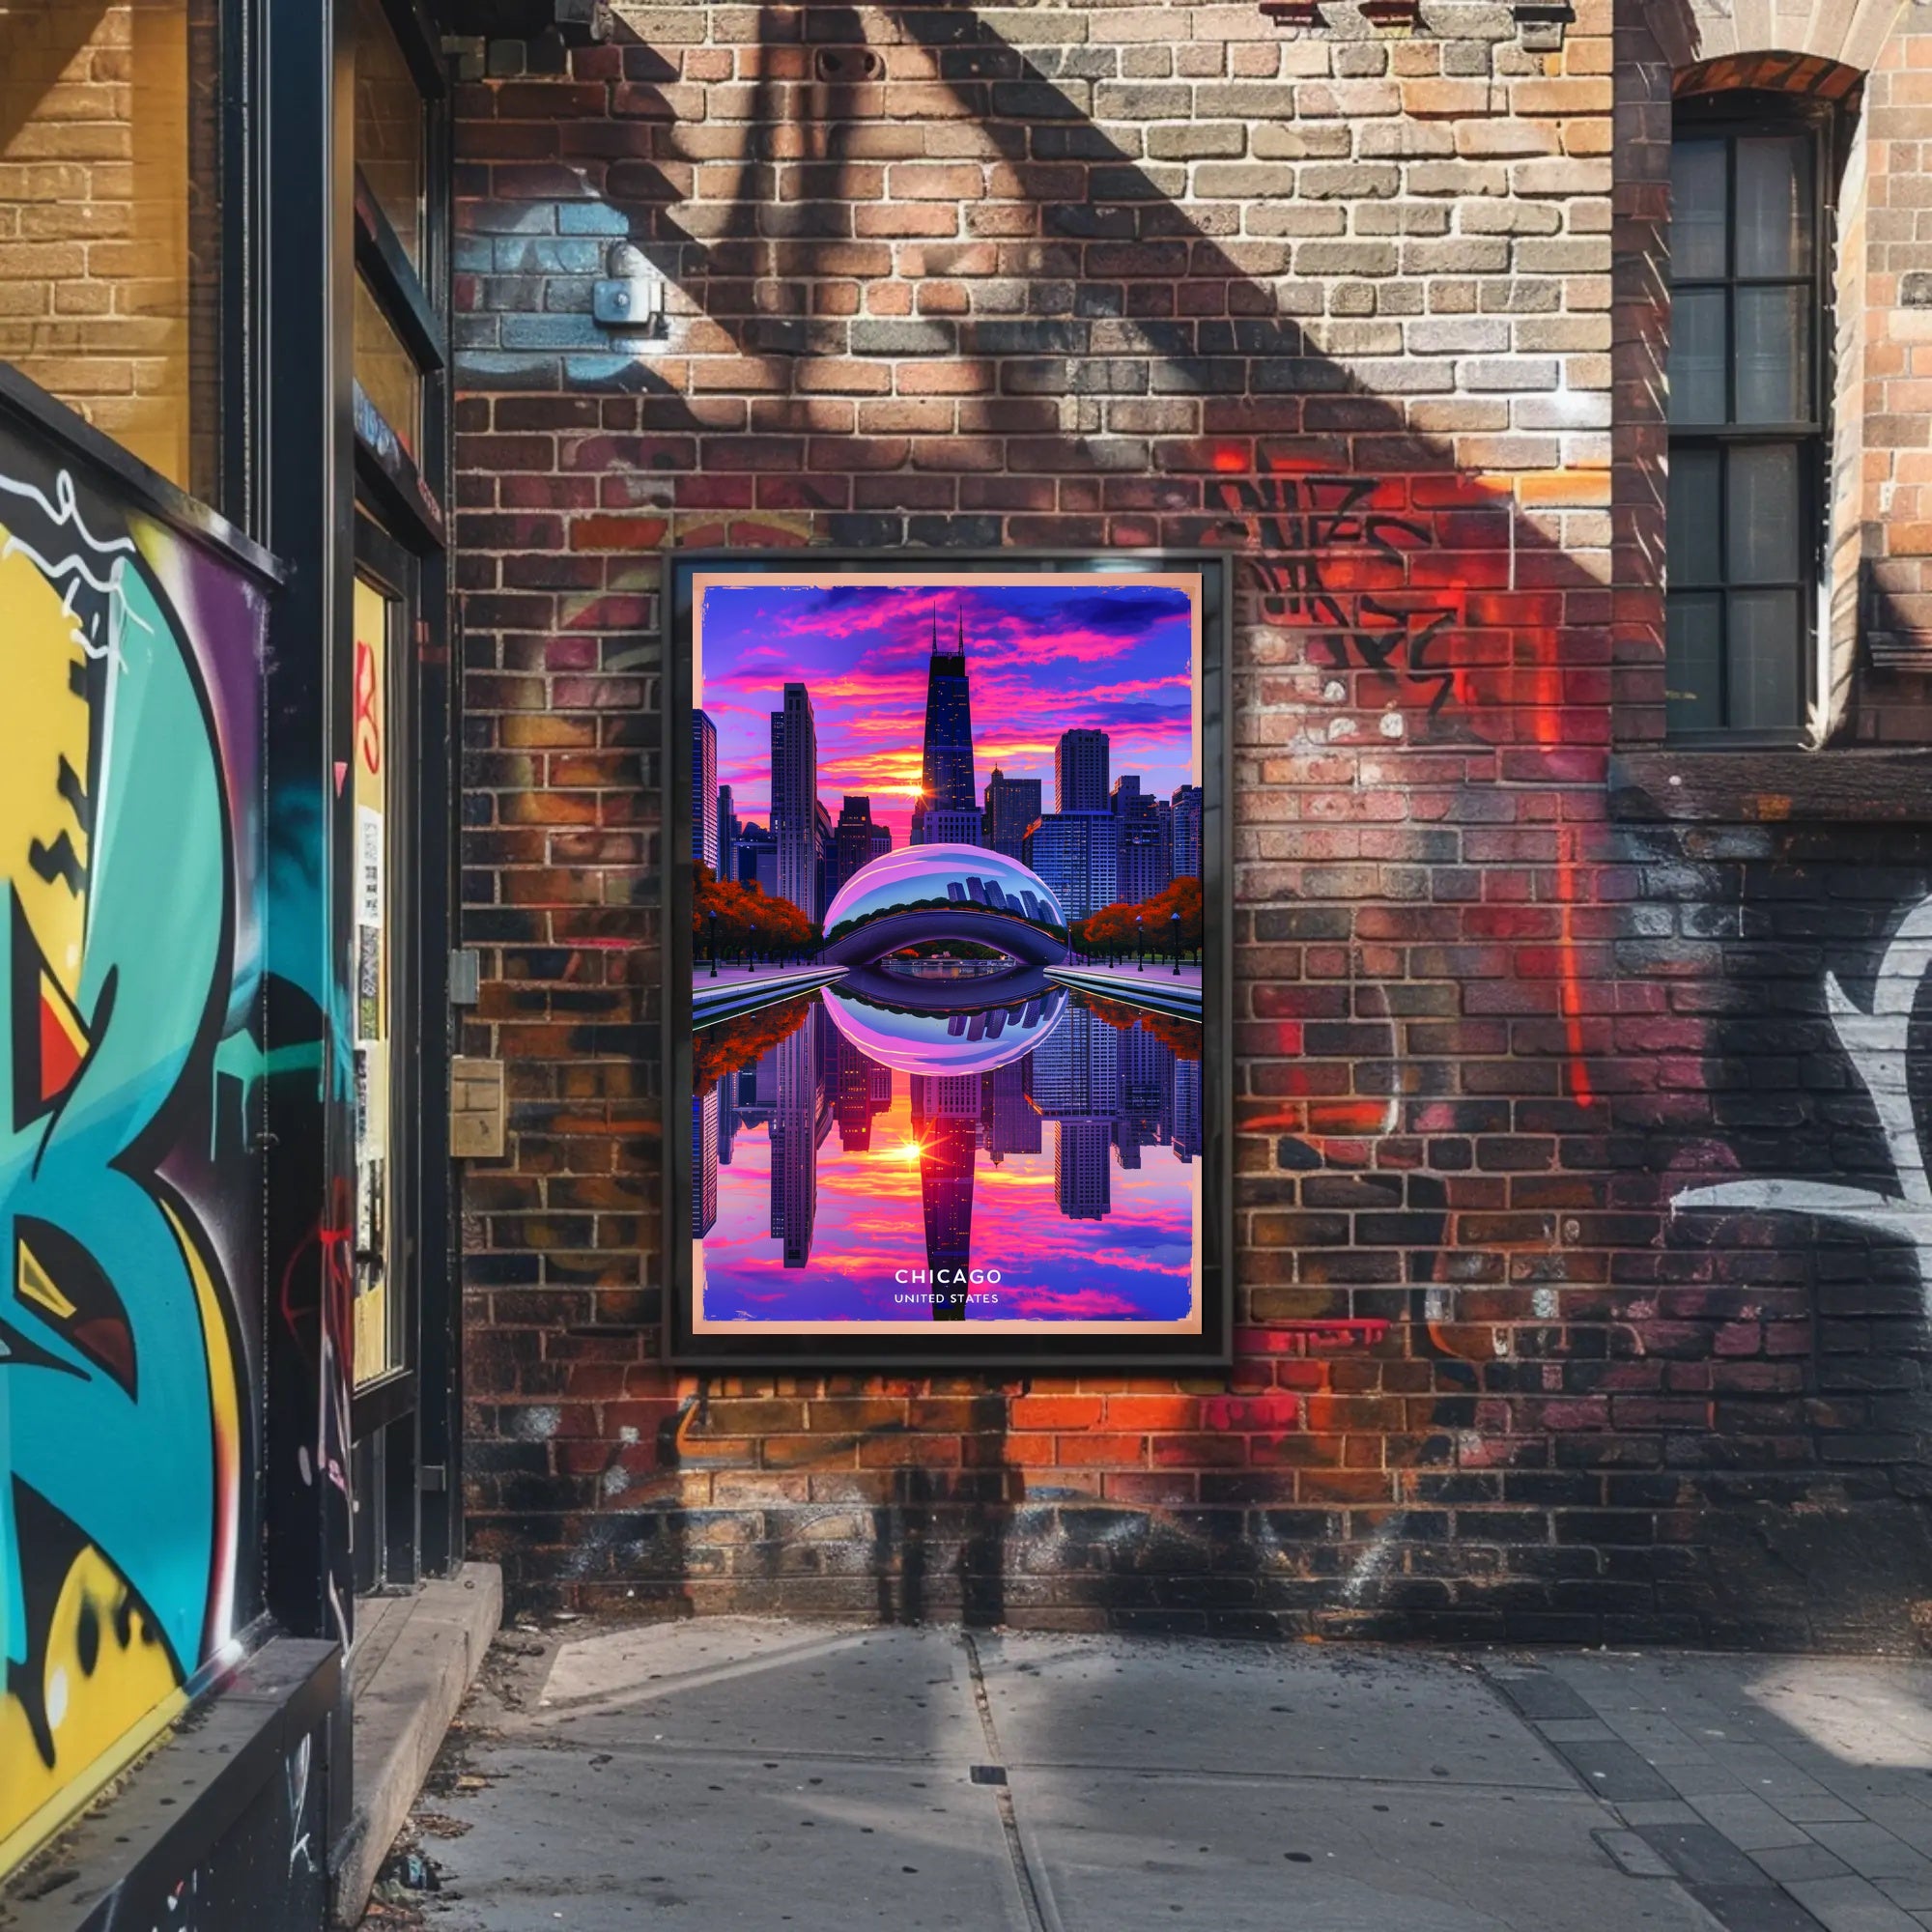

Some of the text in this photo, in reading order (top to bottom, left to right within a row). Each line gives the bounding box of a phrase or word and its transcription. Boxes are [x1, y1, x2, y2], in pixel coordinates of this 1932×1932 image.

[895, 1268, 1002, 1284] CHICAGO
[895, 1293, 999, 1303] UNITED STATES
